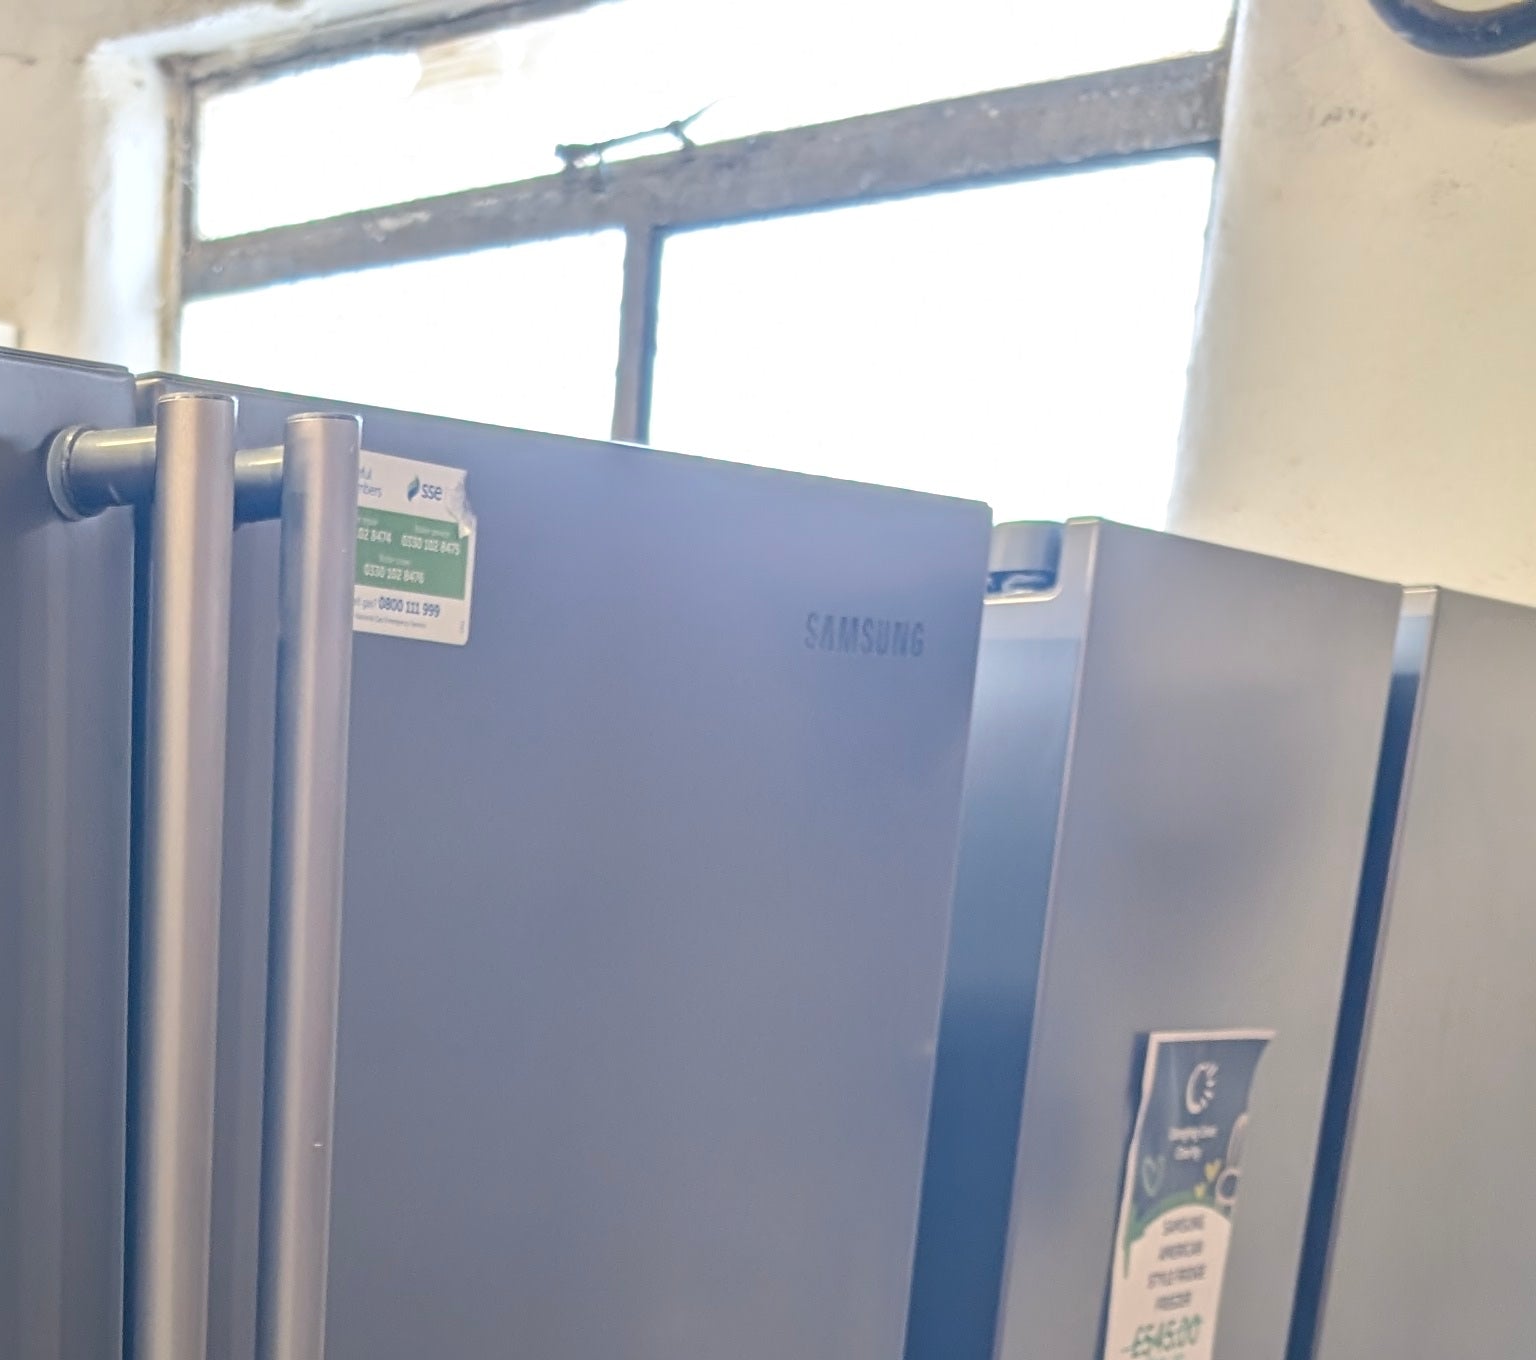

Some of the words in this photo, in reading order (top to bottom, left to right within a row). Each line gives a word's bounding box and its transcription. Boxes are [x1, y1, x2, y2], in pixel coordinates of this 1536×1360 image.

[401, 534, 423, 550] 0330
[363, 562, 385, 579] 0330
[378, 596, 404, 613] 0800
[405, 600, 420, 616] 111
[422, 602, 441, 619] 999
[804, 611, 924, 657] SAMSUNG
